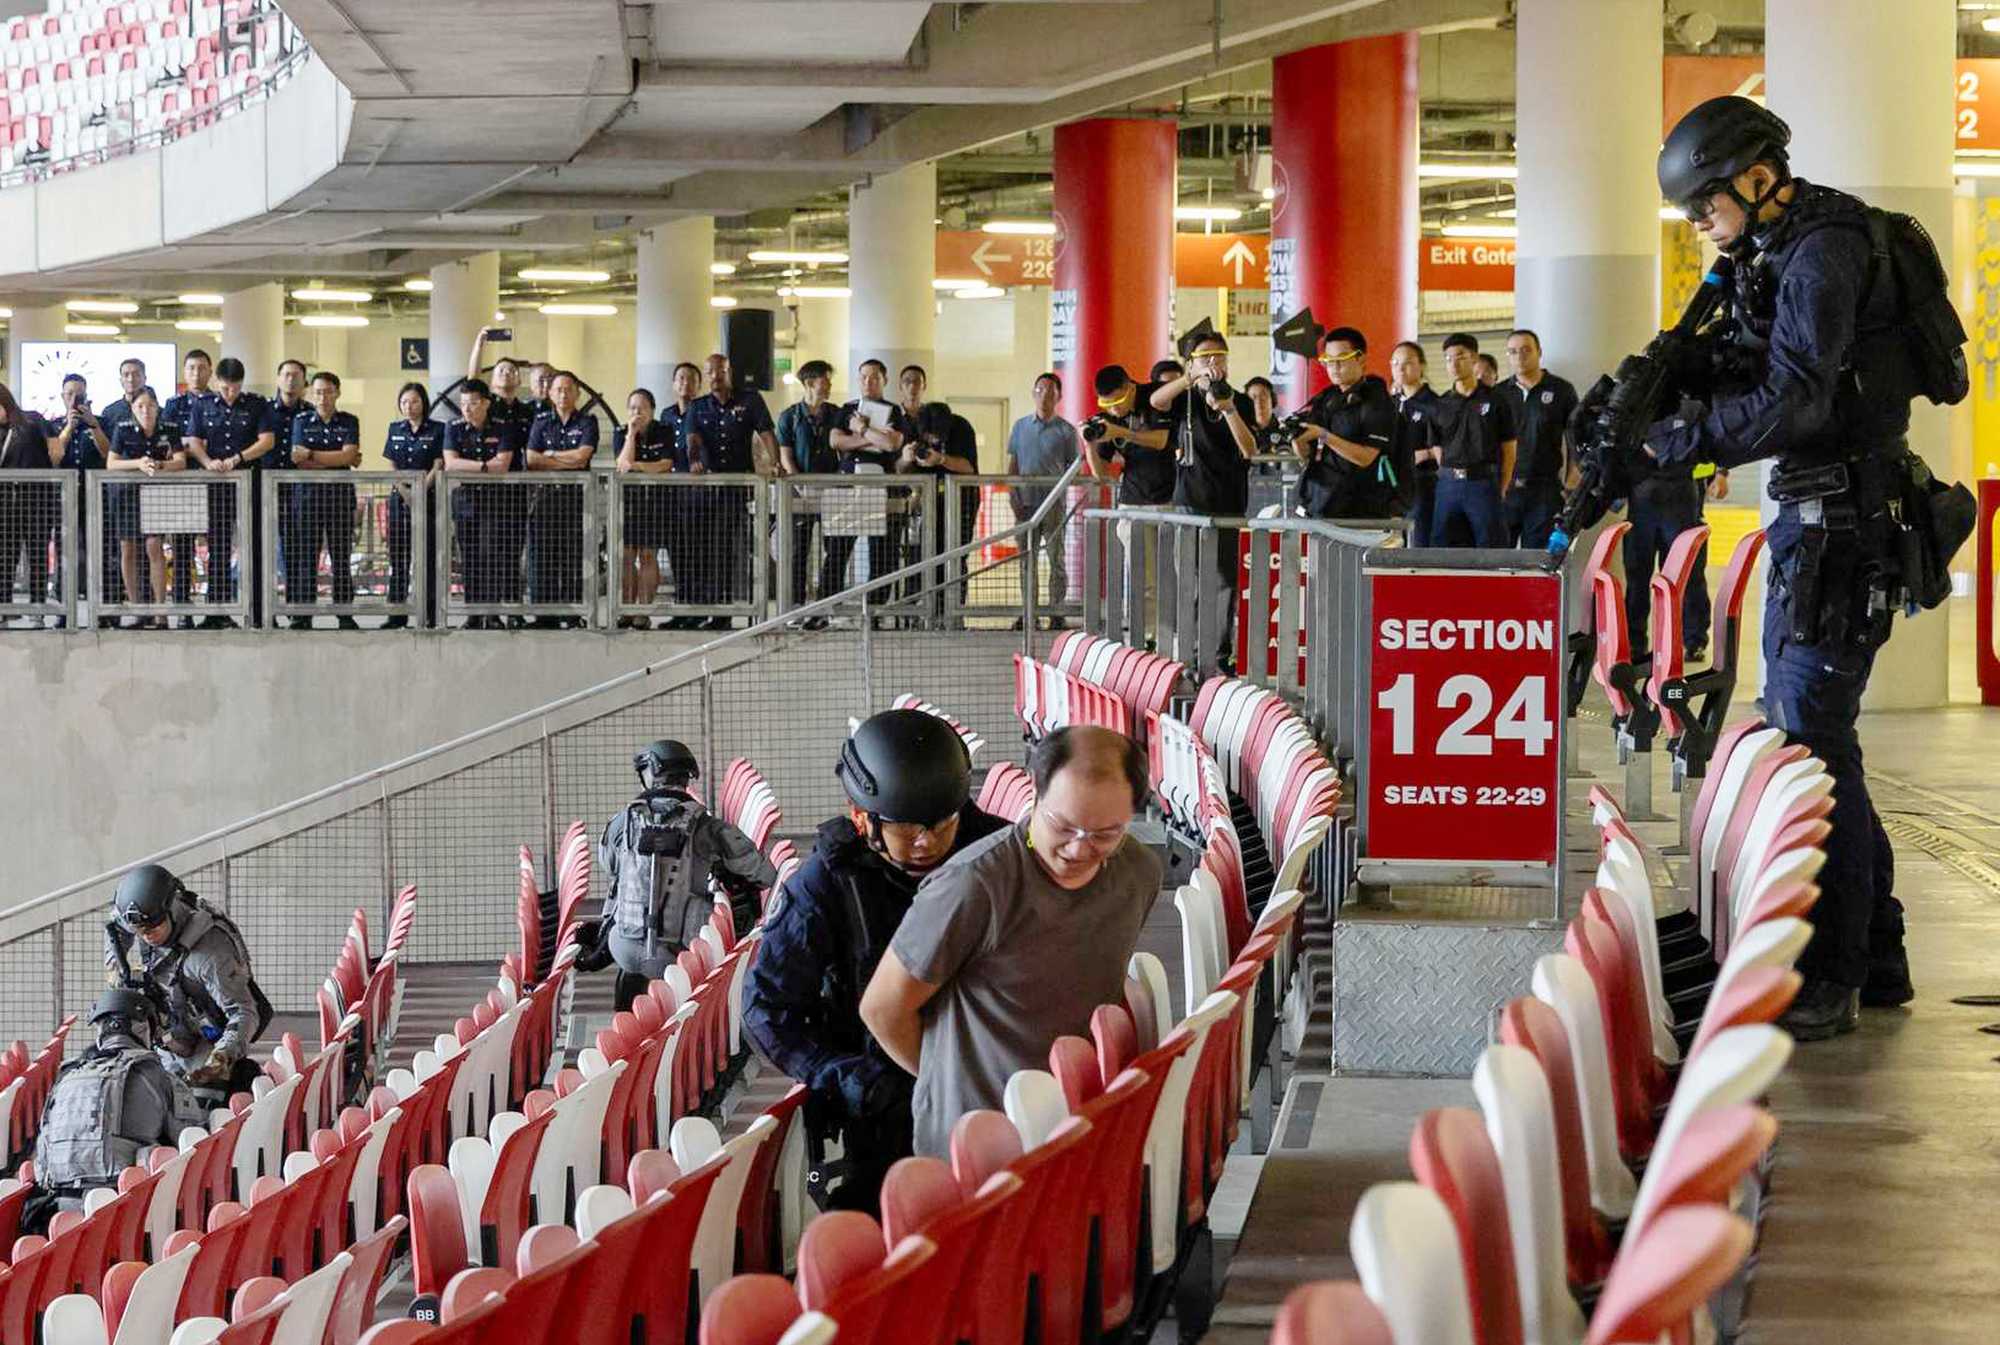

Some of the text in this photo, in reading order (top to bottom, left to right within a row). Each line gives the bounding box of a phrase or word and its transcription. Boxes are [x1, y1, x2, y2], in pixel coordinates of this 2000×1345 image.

[1431, 246, 1467, 265] Exit
[1380, 619, 1553, 650] SECTION
[1668, 688, 1683, 698] EE
[1378, 673, 1553, 756] 124
[1384, 785, 1546, 806] SEATS 22-29
[807, 1171, 820, 1182] C
[416, 1309, 435, 1321] BB
